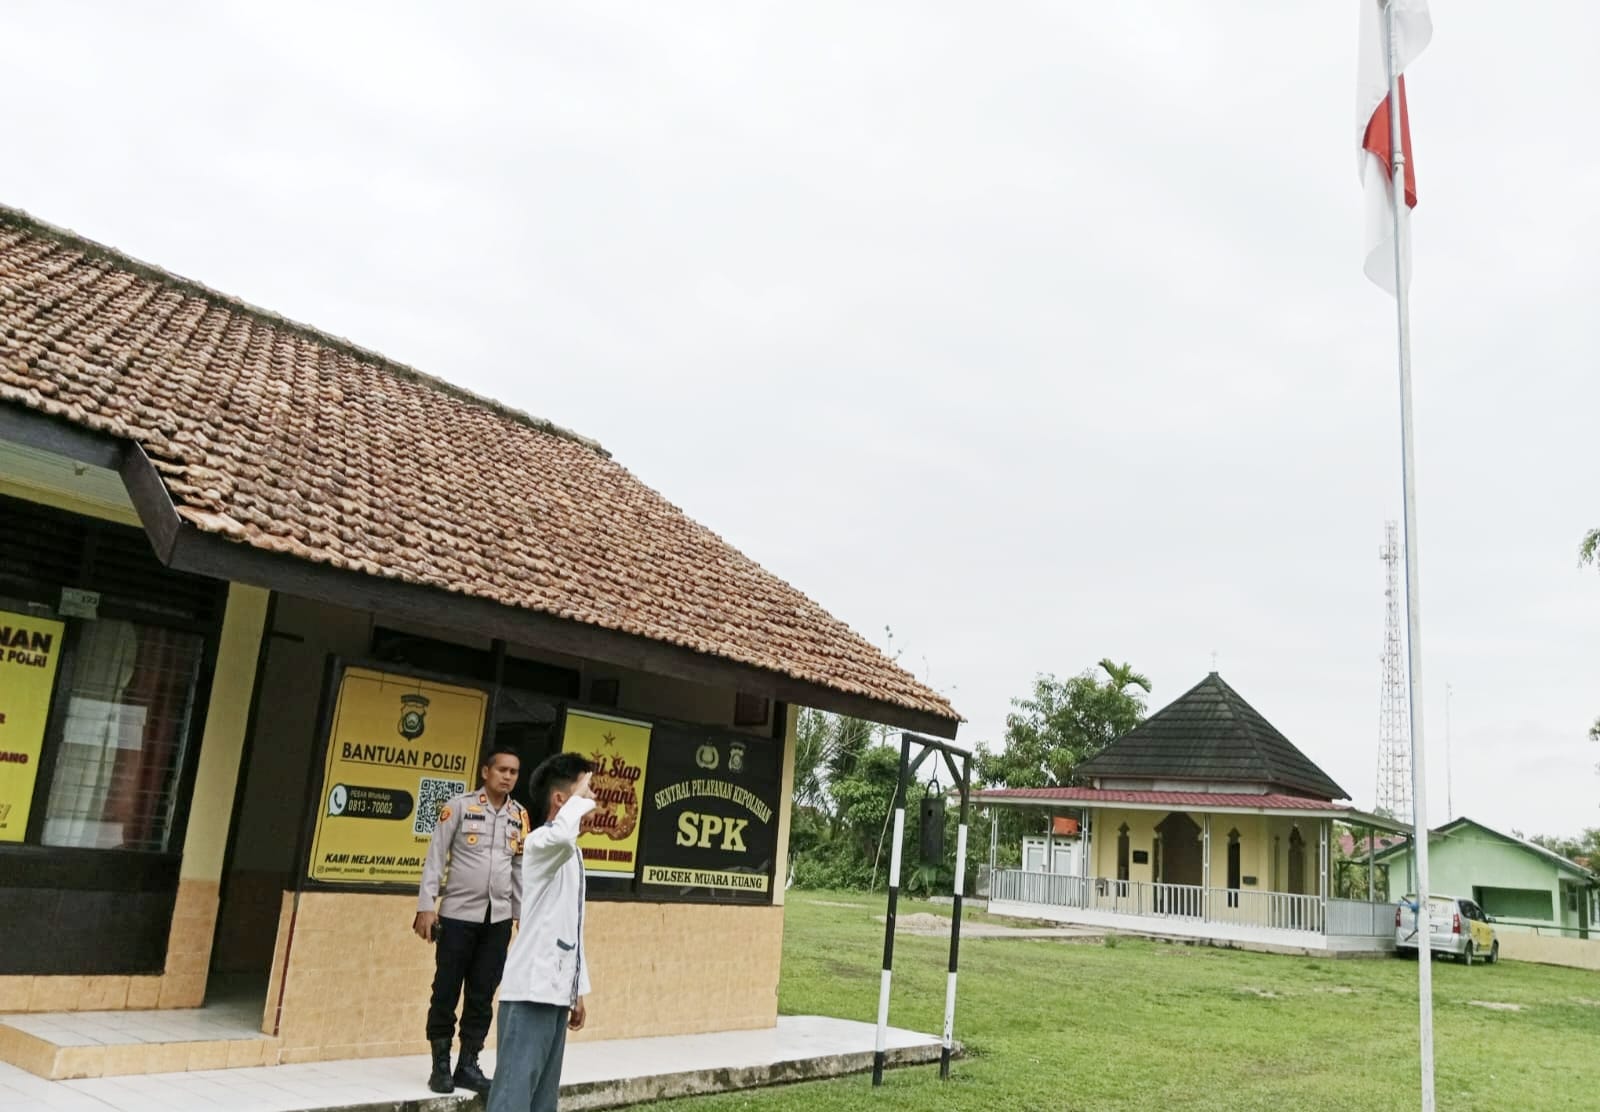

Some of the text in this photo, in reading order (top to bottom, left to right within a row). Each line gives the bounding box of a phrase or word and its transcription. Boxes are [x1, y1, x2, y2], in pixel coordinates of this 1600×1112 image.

[7, 651, 47, 668] POLRI
[342, 742, 467, 772] BANTUAN POLISI
[609, 758, 641, 786] Siap
[348, 799, 366, 812] 0813
[655, 780, 773, 824] SENTRAL PELAYANAN KEPOLISIAN
[676, 811, 749, 852] SPK
[325, 853, 350, 864] KAMI
[351, 854, 396, 866] MELAYANI
[397, 856, 420, 867] ANDA
[648, 869, 763, 889] POLSEK MUARA KUANG
